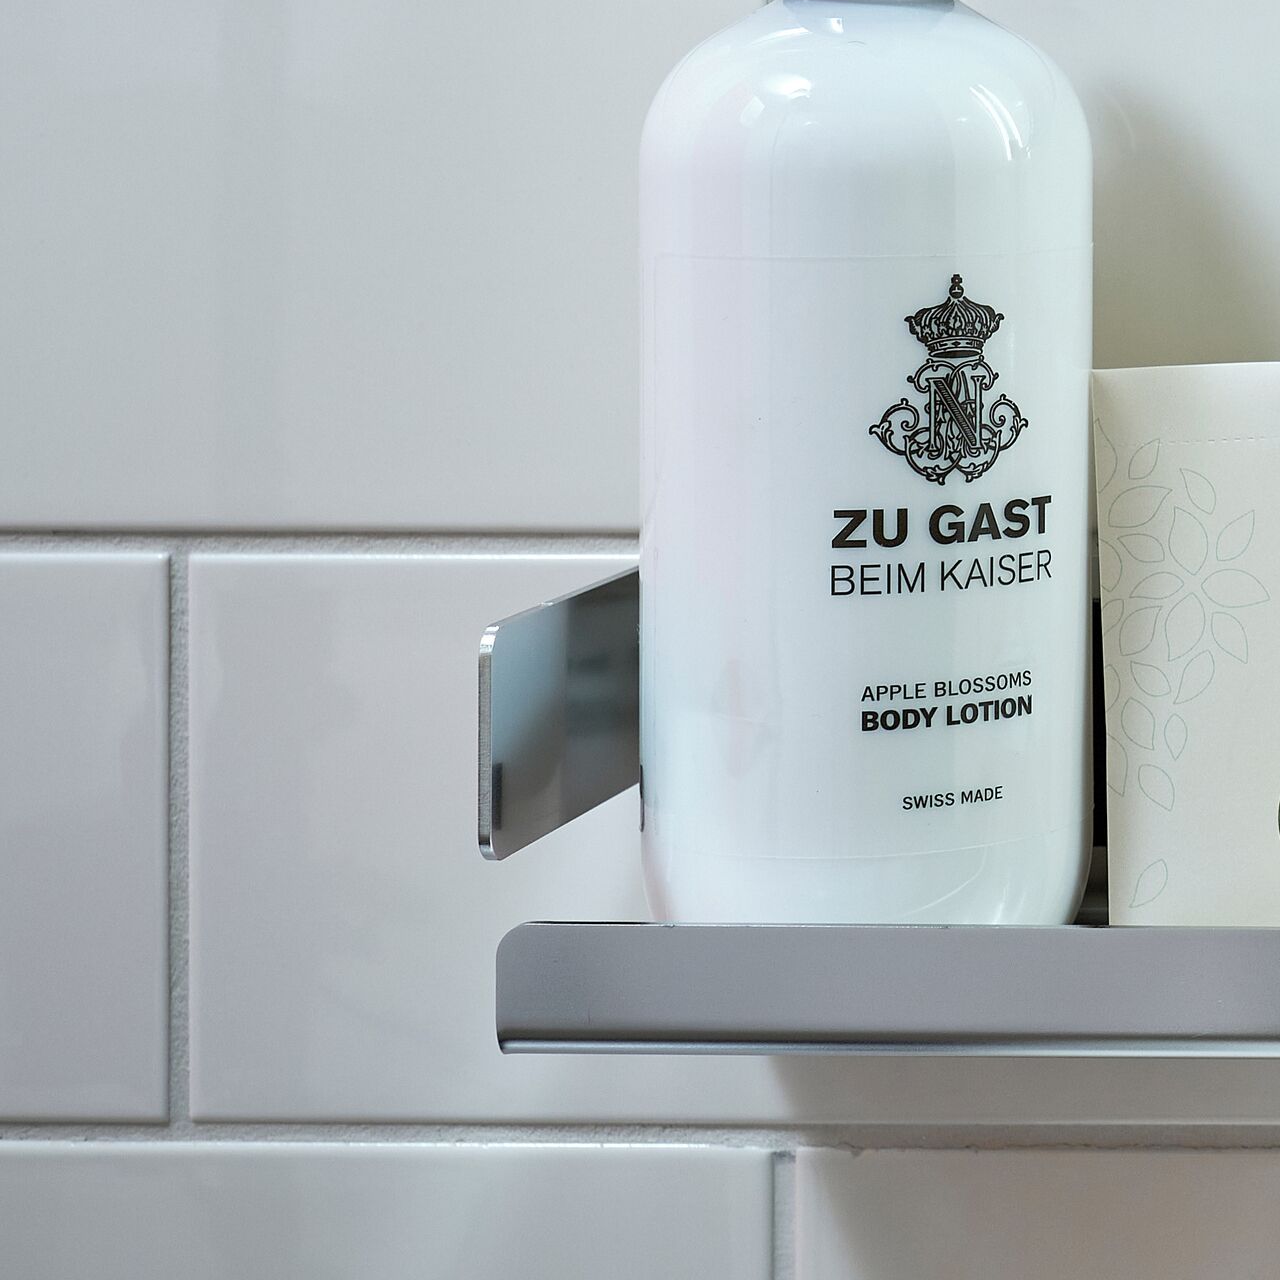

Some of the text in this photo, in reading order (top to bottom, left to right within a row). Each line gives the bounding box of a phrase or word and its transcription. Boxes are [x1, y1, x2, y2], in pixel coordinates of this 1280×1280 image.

[831, 494, 1053, 549] ZU GAST
[830, 549, 1052, 596] BEIM KAISER
[860, 670, 1032, 702] APPLE BLOSSOMS
[861, 694, 1033, 732] BODY LOTION
[902, 785, 1003, 810] SWISS MADE
